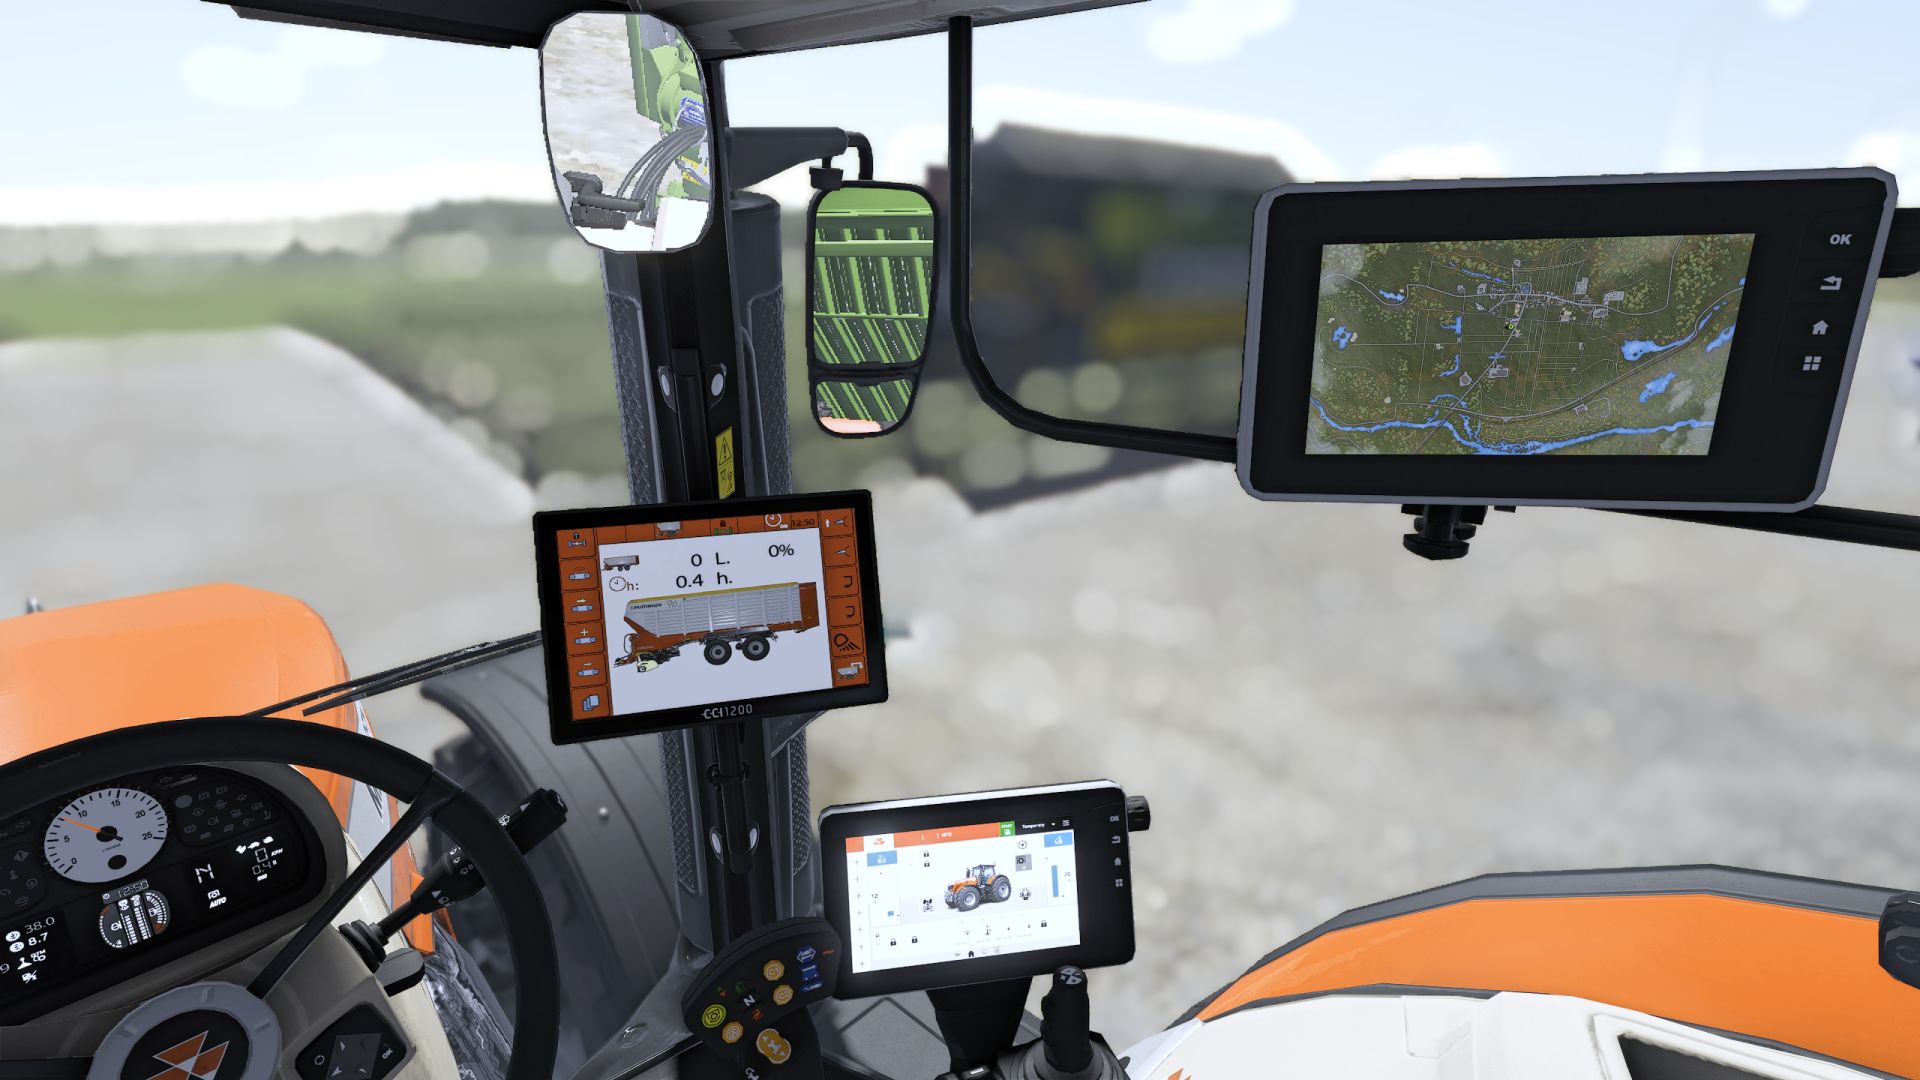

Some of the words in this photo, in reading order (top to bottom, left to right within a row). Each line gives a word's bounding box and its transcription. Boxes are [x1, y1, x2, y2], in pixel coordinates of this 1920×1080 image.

[1829, 233, 1853, 245] OK
[790, 518, 815, 527] 12:50
[768, 543, 795, 558] 0%
[690, 553, 703, 567] 0
[715, 551, 731, 565] L.
[675, 573, 704, 589] 0.4
[716, 571, 733, 585] h.
[626, 581, 640, 592] h:
[110, 799, 121, 809] 15
[77, 809, 88, 819] 10
[134, 808, 147, 819] 20
[1109, 815, 1120, 823] OK
[63, 834, 71, 843] 5
[141, 830, 153, 841] 25
[70, 857, 78, 865] 0
[117, 880, 150, 898] 12:50
[209, 896, 227, 909] AUTO
[24, 916, 55, 935] 38.0
[28, 931, 49, 946] 8.7
[743, 994, 756, 1007] N
[382, 1047, 394, 1060] OK
